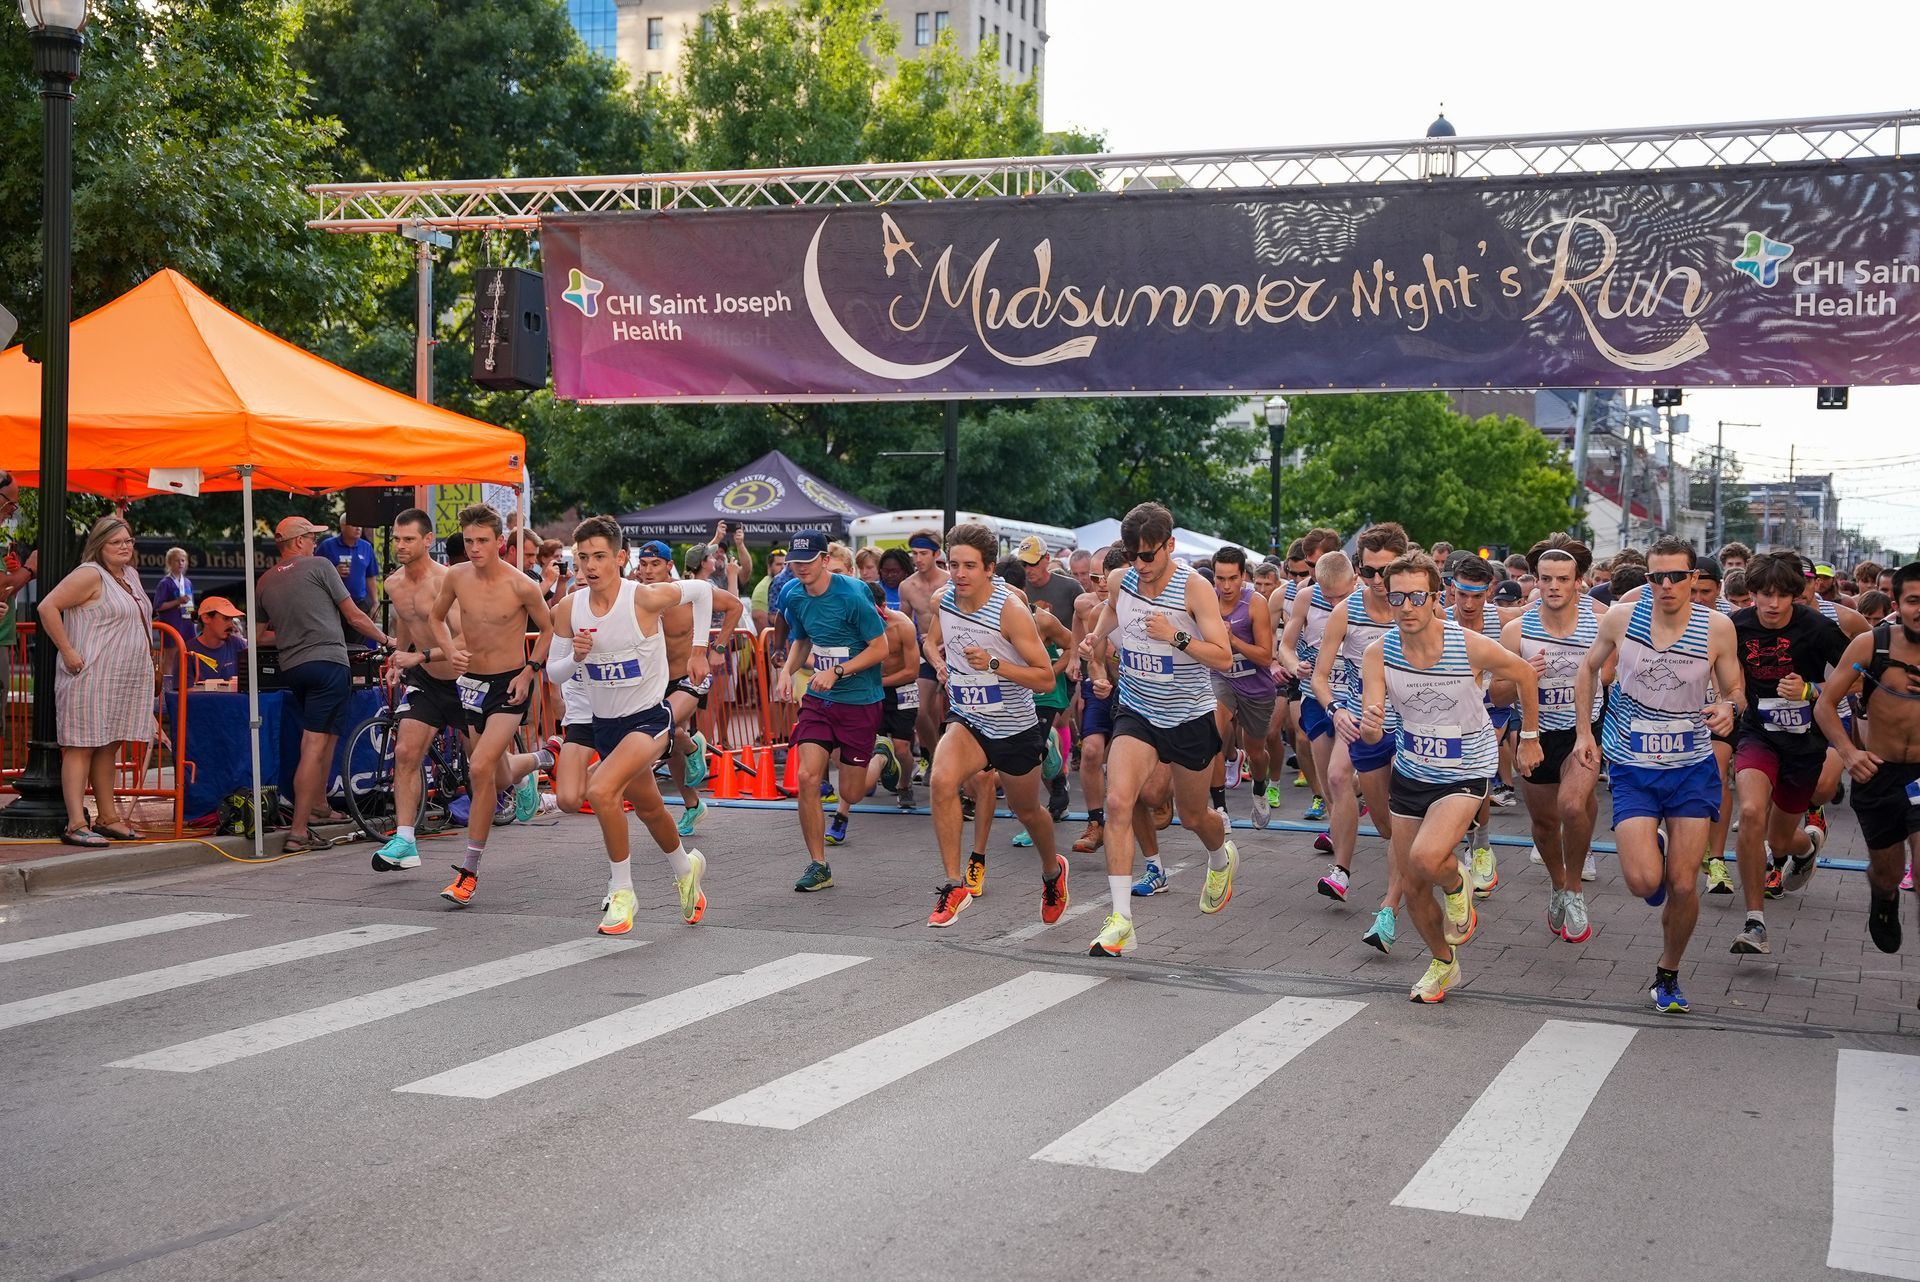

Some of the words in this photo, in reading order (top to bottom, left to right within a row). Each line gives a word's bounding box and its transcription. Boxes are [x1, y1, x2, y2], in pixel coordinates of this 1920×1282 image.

[881, 212, 922, 277] A
[1793, 261, 1845, 285] CHI
[1855, 259, 1920, 285] Sain
[1521, 208, 1713, 372] Run
[606, 295, 643, 316] CHI
[650, 293, 708, 315] Saint
[713, 290, 793, 318] Joseph
[889, 238, 1337, 367] Midsummer
[1795, 290, 1897, 317] Health
[612, 320, 683, 342] Health
[642, 524, 665, 535] SIXTH
[668, 524, 707, 534] BREWING
[206, 551, 245, 568] Irish
[597, 663, 626, 680] 721
[1128, 652, 1163, 673] 1185
[1434, 679, 1461, 687] CHILDREN
[960, 686, 989, 705] 321
[1545, 687, 1575, 705] 370
[1769, 709, 1803, 726] 205
[1413, 735, 1448, 758] 326
[1640, 733, 1685, 753] 1604
